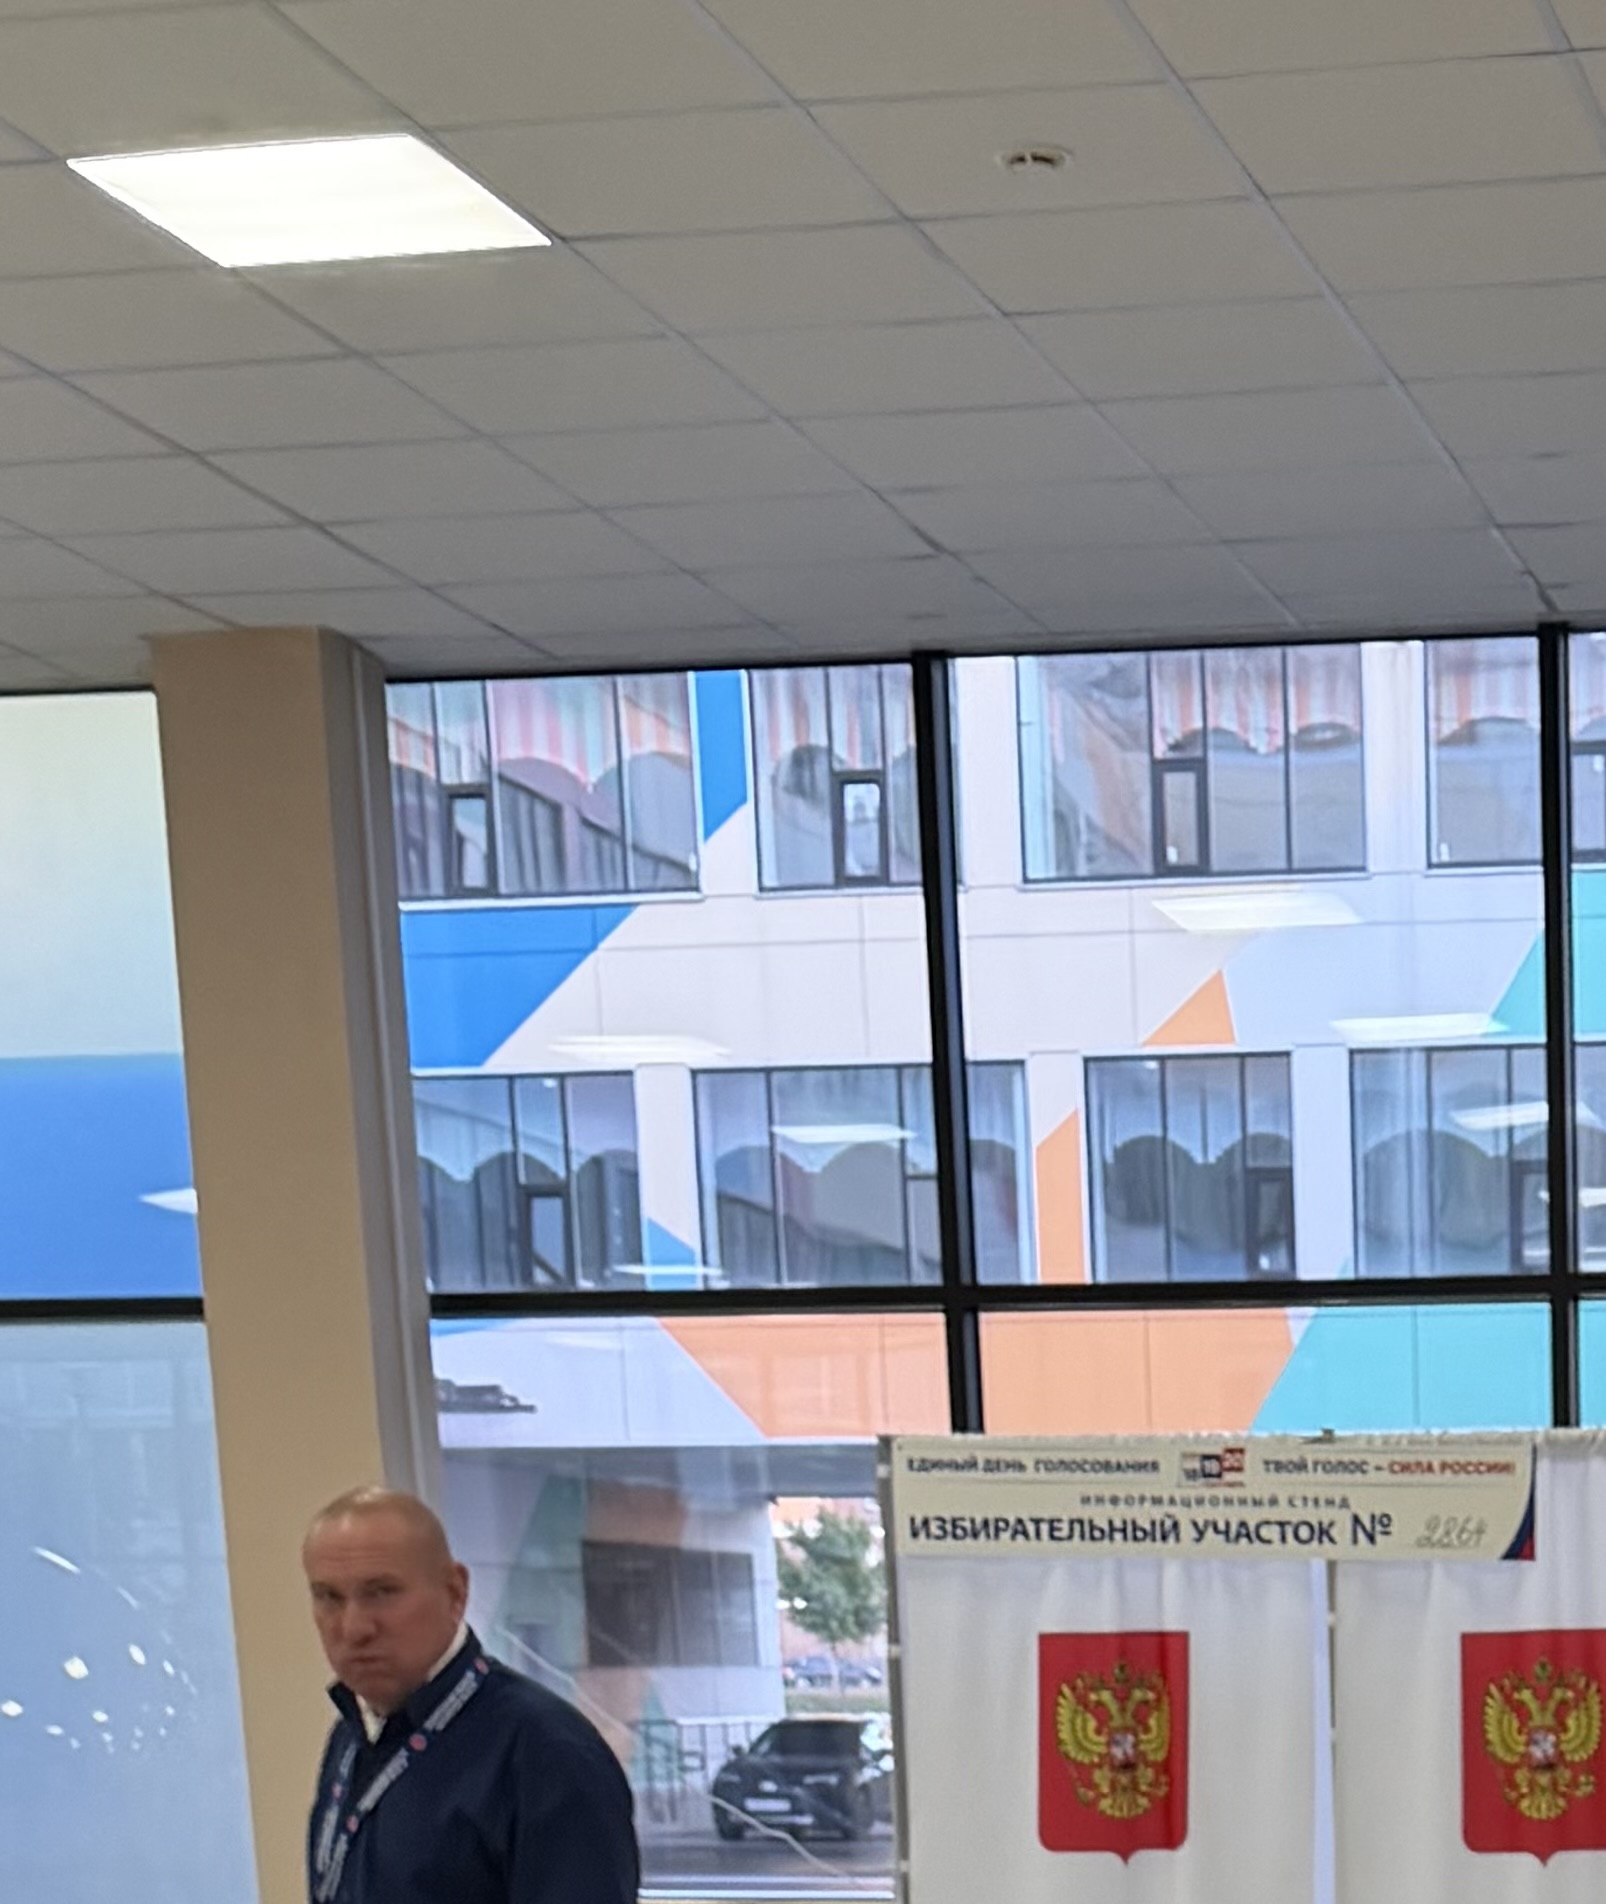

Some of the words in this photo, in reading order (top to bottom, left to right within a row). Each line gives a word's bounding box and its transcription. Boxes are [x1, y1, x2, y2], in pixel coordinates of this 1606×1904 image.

[907, 1455, 978, 1473] ЕДИНЫЙ
[982, 1458, 1027, 1474] ДЕНЬ
[1034, 1459, 1160, 1474] ГОЛОСОВАНИЯ
[1263, 1457, 1309, 1474] ТВОЙ
[1313, 1459, 1370, 1475] ГОЛОС
[1387, 1460, 1436, 1475] СИЛА
[1080, 1493, 1280, 1509] ИНФОРМАЦИОННЫЙ
[1287, 1494, 1351, 1510] СТЕНД
[908, 1514, 1181, 1543] ИЗБИРАТЕЛЬНЫЙ
[1190, 1519, 1338, 1545] УЧАСТОК
[1352, 1513, 1392, 1546] №
